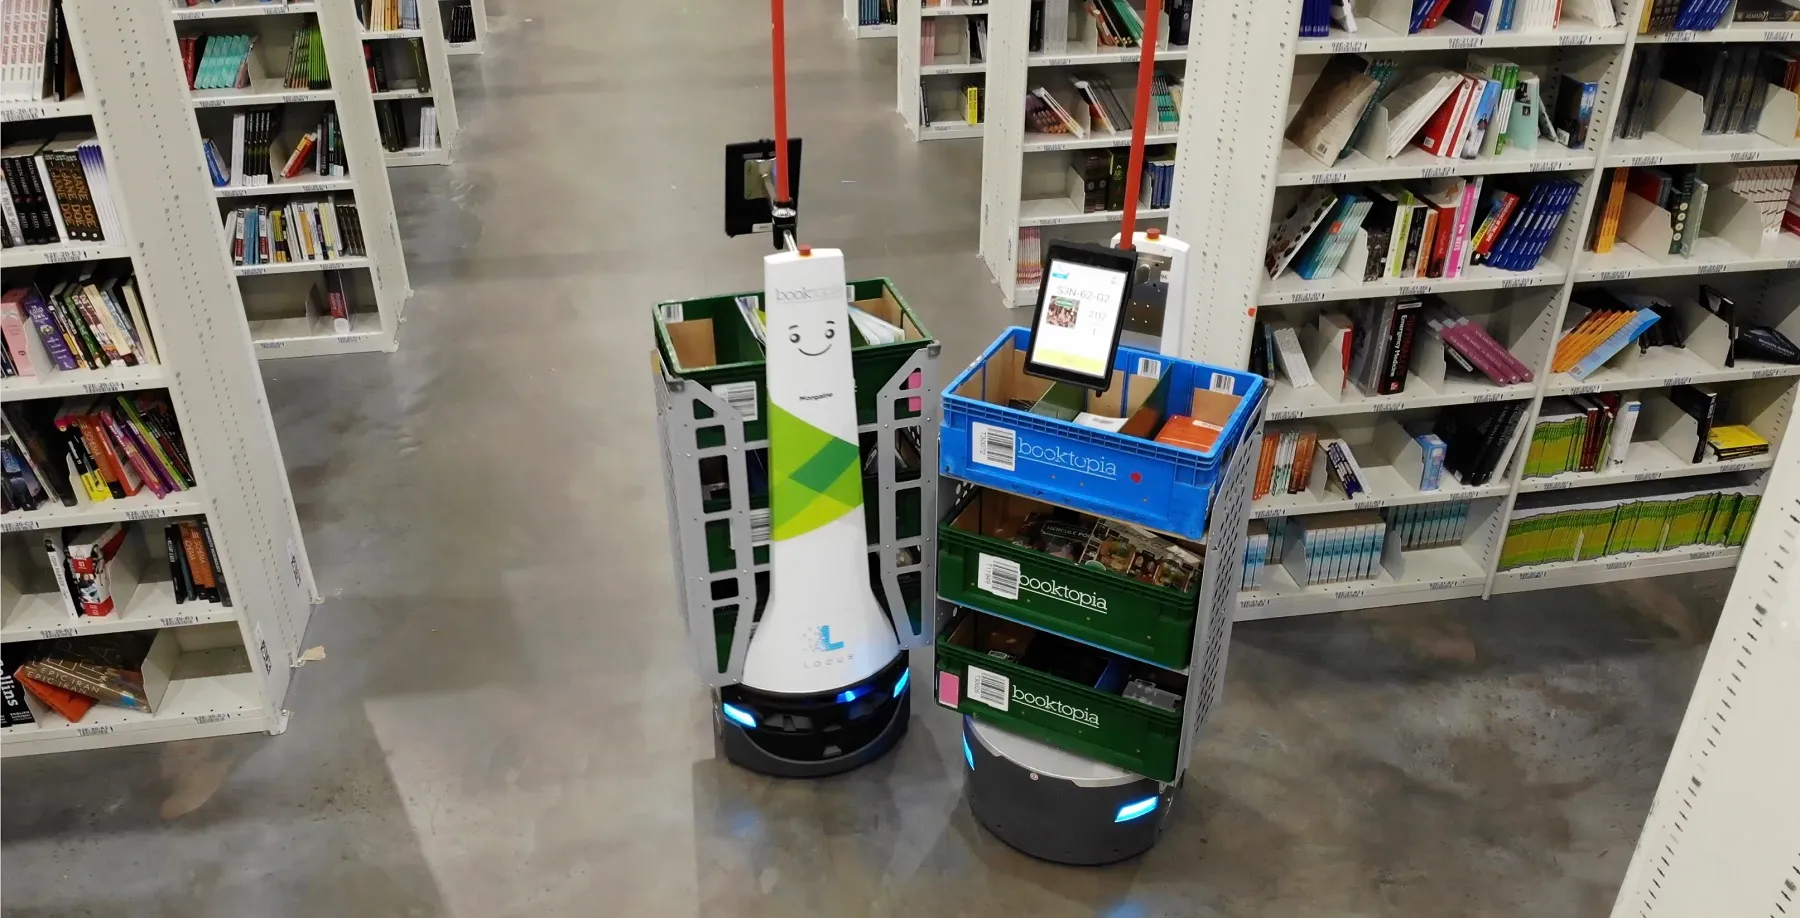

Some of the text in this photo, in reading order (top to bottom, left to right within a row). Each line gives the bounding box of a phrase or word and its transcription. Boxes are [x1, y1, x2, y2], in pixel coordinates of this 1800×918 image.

[51, 172, 67, 200] JANE
[61, 203, 75, 226] DOE
[62, 172, 86, 227] JANE DOE
[72, 172, 97, 228] JANE DOE
[1389, 314, 1408, 377] Emergency Medicine
[1018, 437, 1118, 476] booktopia
[1047, 525, 1077, 536] HERCULE
[41, 667, 100, 693] EPIC IRAN
[803, 654, 853, 668] LOCUS
[27, 671, 87, 694] EPIC IRAN
[1012, 685, 1099, 725] booktopia
